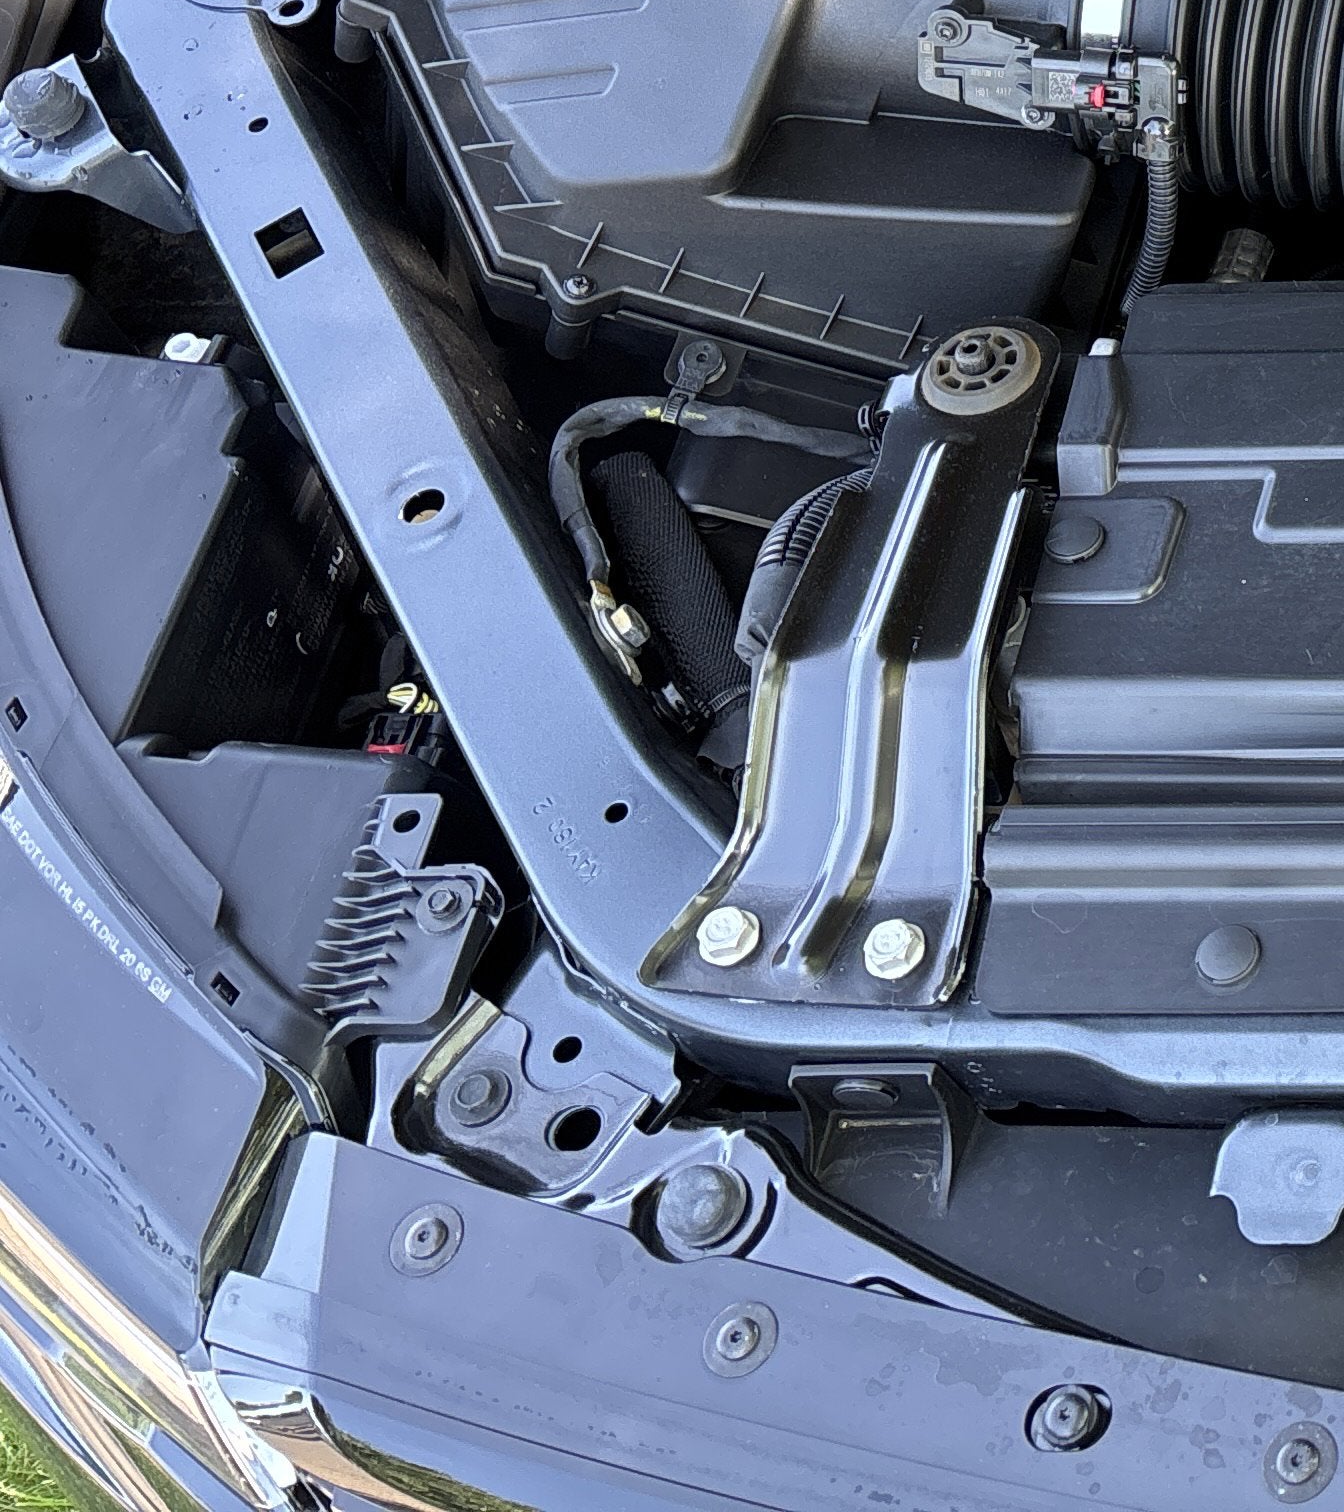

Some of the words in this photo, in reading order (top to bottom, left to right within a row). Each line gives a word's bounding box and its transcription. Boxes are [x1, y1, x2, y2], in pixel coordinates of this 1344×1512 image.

[1, 807, 23, 836] SAE
[17, 830, 42, 861] DOT
[38, 854, 62, 886] VOR
[97, 924, 120, 956] DRL
[119, 948, 137, 967] 20
[148, 976, 173, 1004] GM
